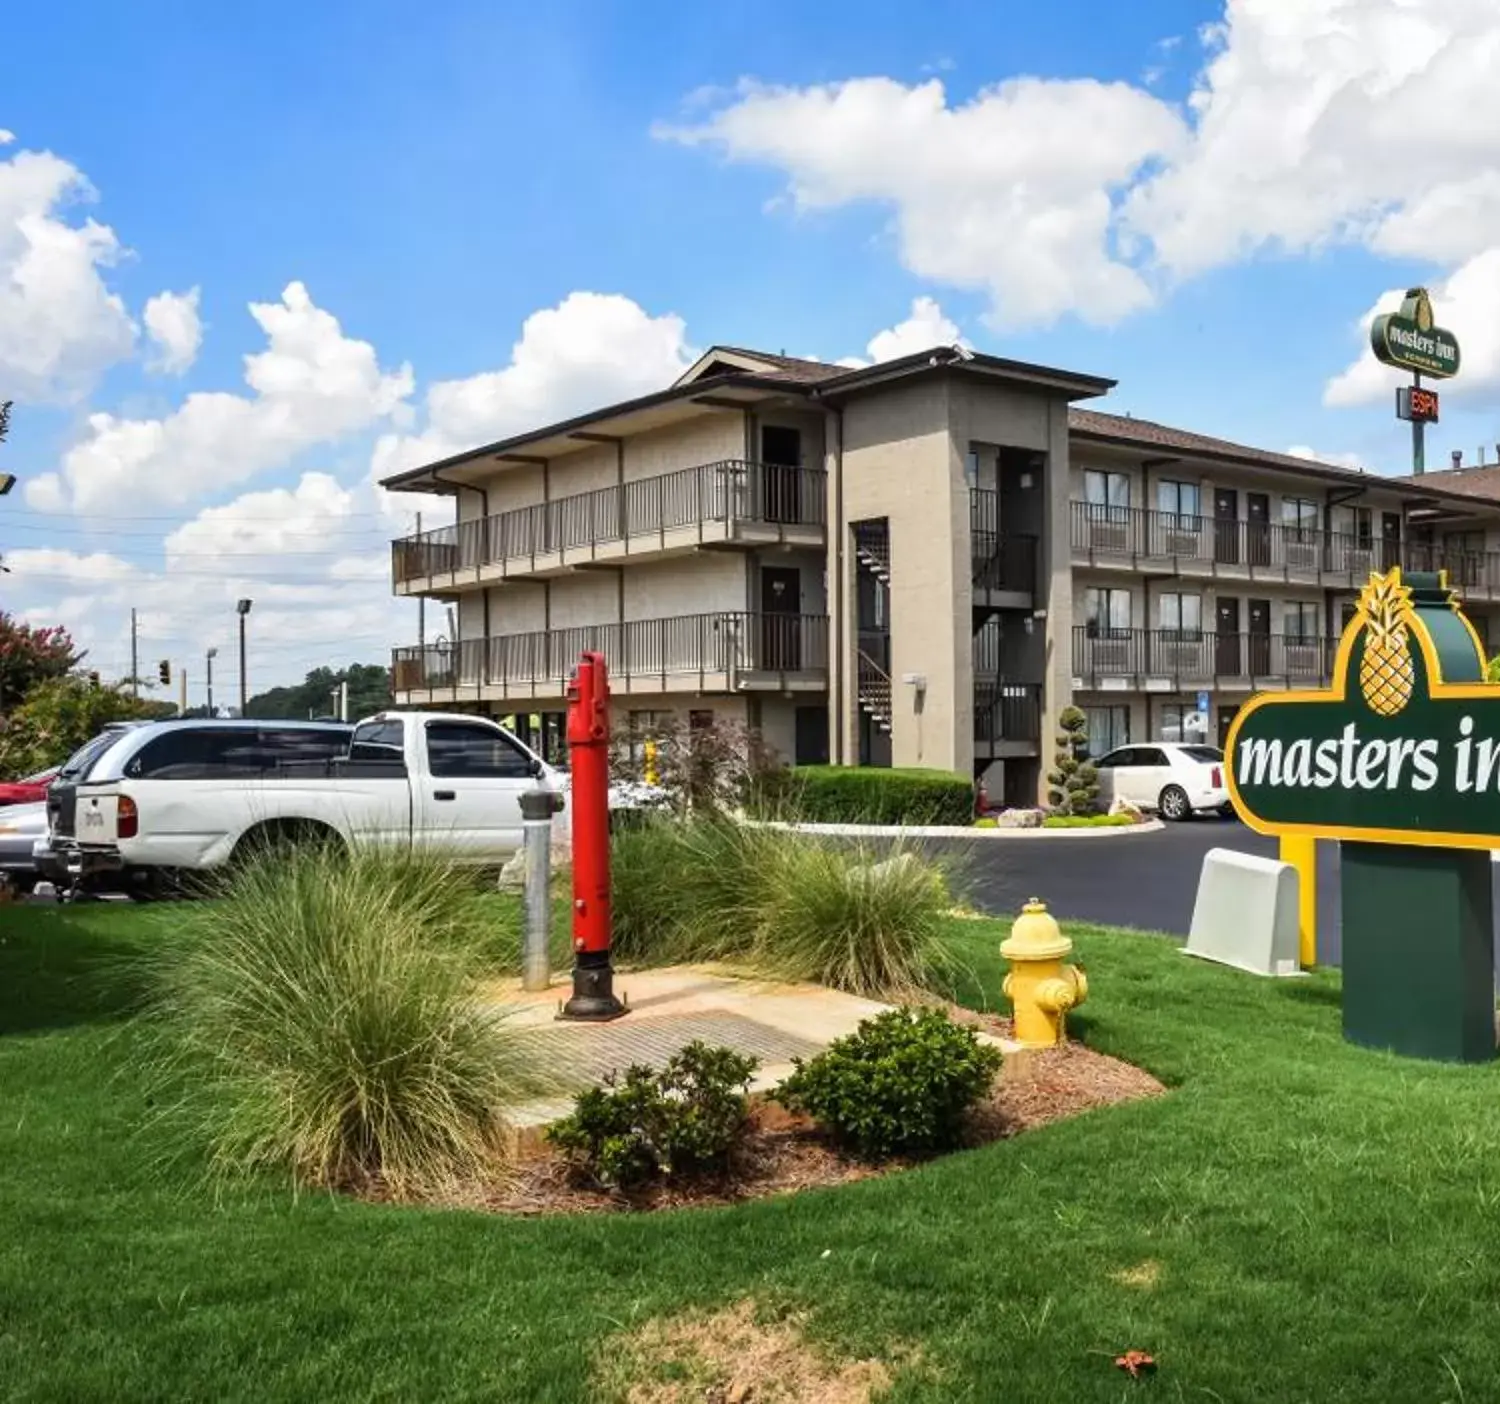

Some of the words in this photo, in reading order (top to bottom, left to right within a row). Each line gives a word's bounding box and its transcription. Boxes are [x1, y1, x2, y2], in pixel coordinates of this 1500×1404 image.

[1389, 325, 1434, 355] masters
[1436, 336, 1456, 361] inn
[1411, 391, 1439, 417] ESPN
[1239, 721, 1439, 791] masters
